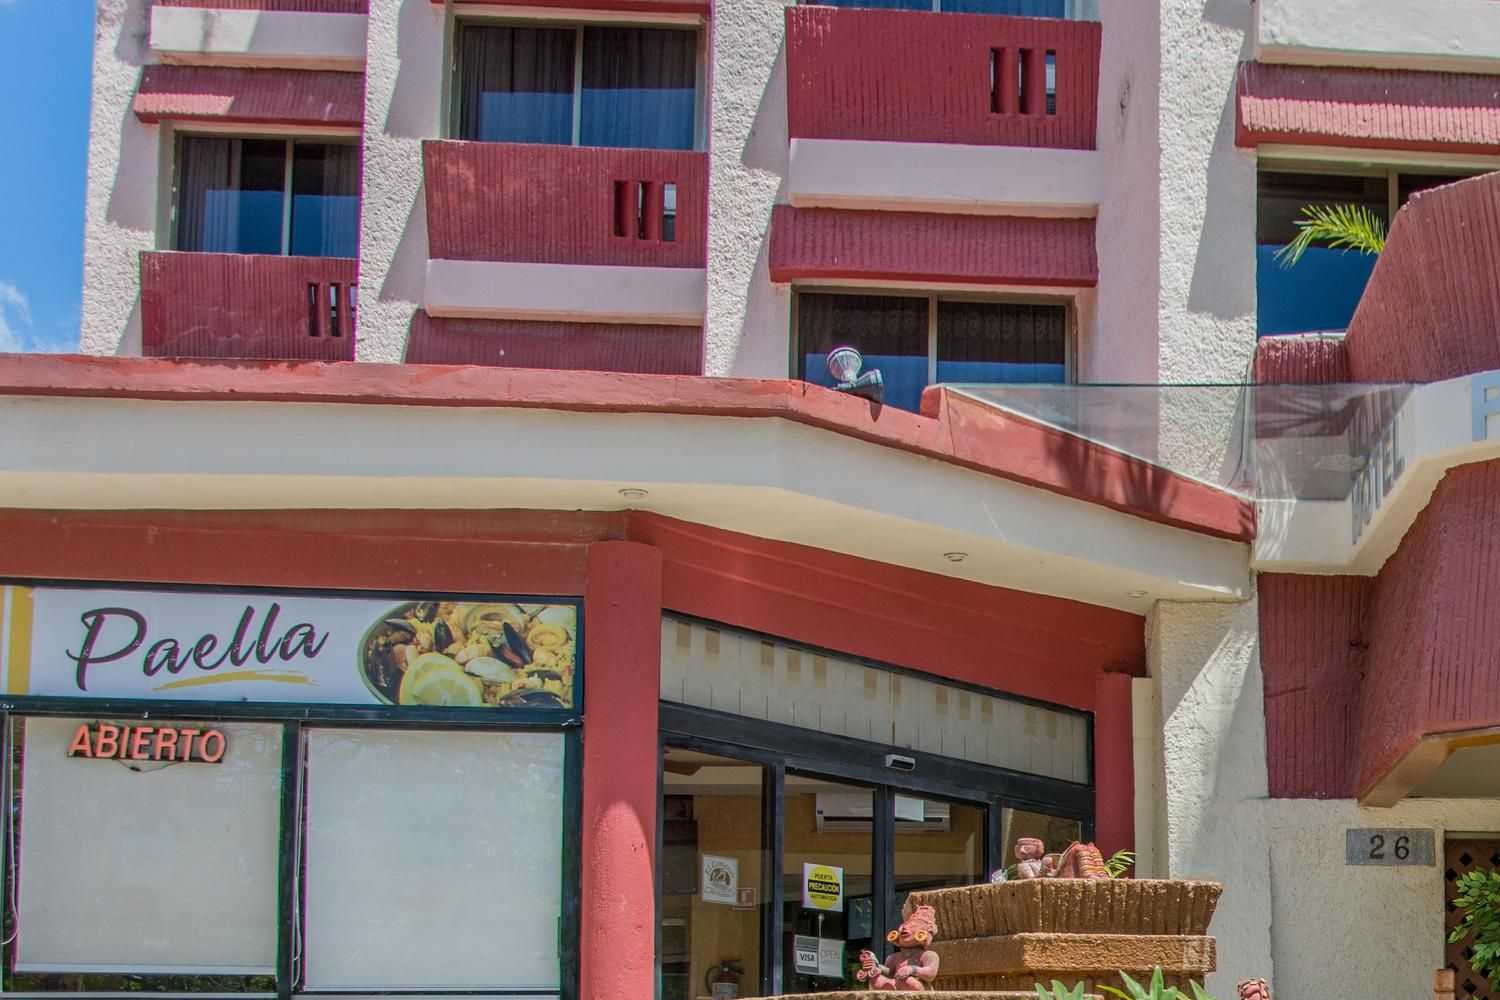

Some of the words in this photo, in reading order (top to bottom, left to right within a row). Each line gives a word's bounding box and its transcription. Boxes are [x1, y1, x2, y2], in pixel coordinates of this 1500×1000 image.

[66, 602, 330, 692] Paella
[67, 723, 227, 764] ABIERTO
[1369, 834, 1410, 860] 26
[814, 873, 834, 881] PUERTA
[808, 881, 840, 893] PRECAUCIÓN
[800, 953, 816, 962] VISA
[820, 950, 840, 960] OPEN
